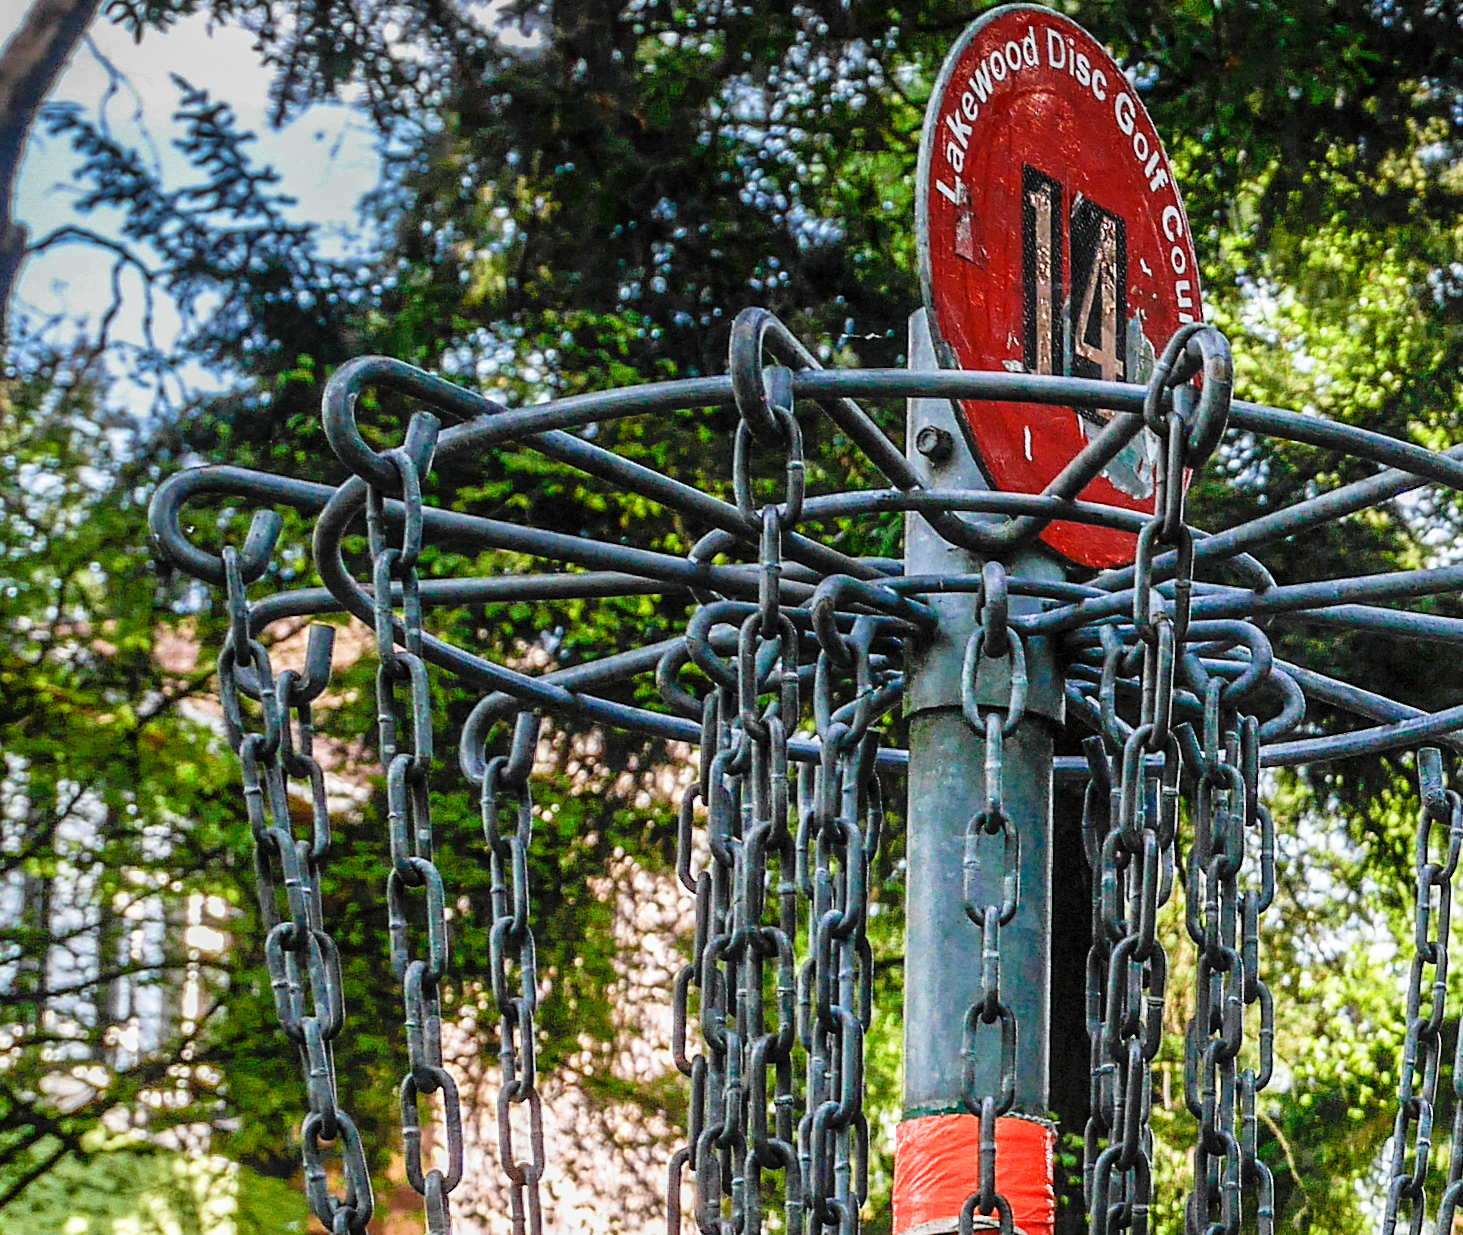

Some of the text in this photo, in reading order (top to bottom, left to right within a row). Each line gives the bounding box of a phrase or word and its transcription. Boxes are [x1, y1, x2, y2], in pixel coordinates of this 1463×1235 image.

[936, 26, 1040, 206] Lakewood
[1046, 27, 1108, 102] Disc
[1114, 92, 1170, 193] Golf
[1028, 181, 1125, 421] 14
